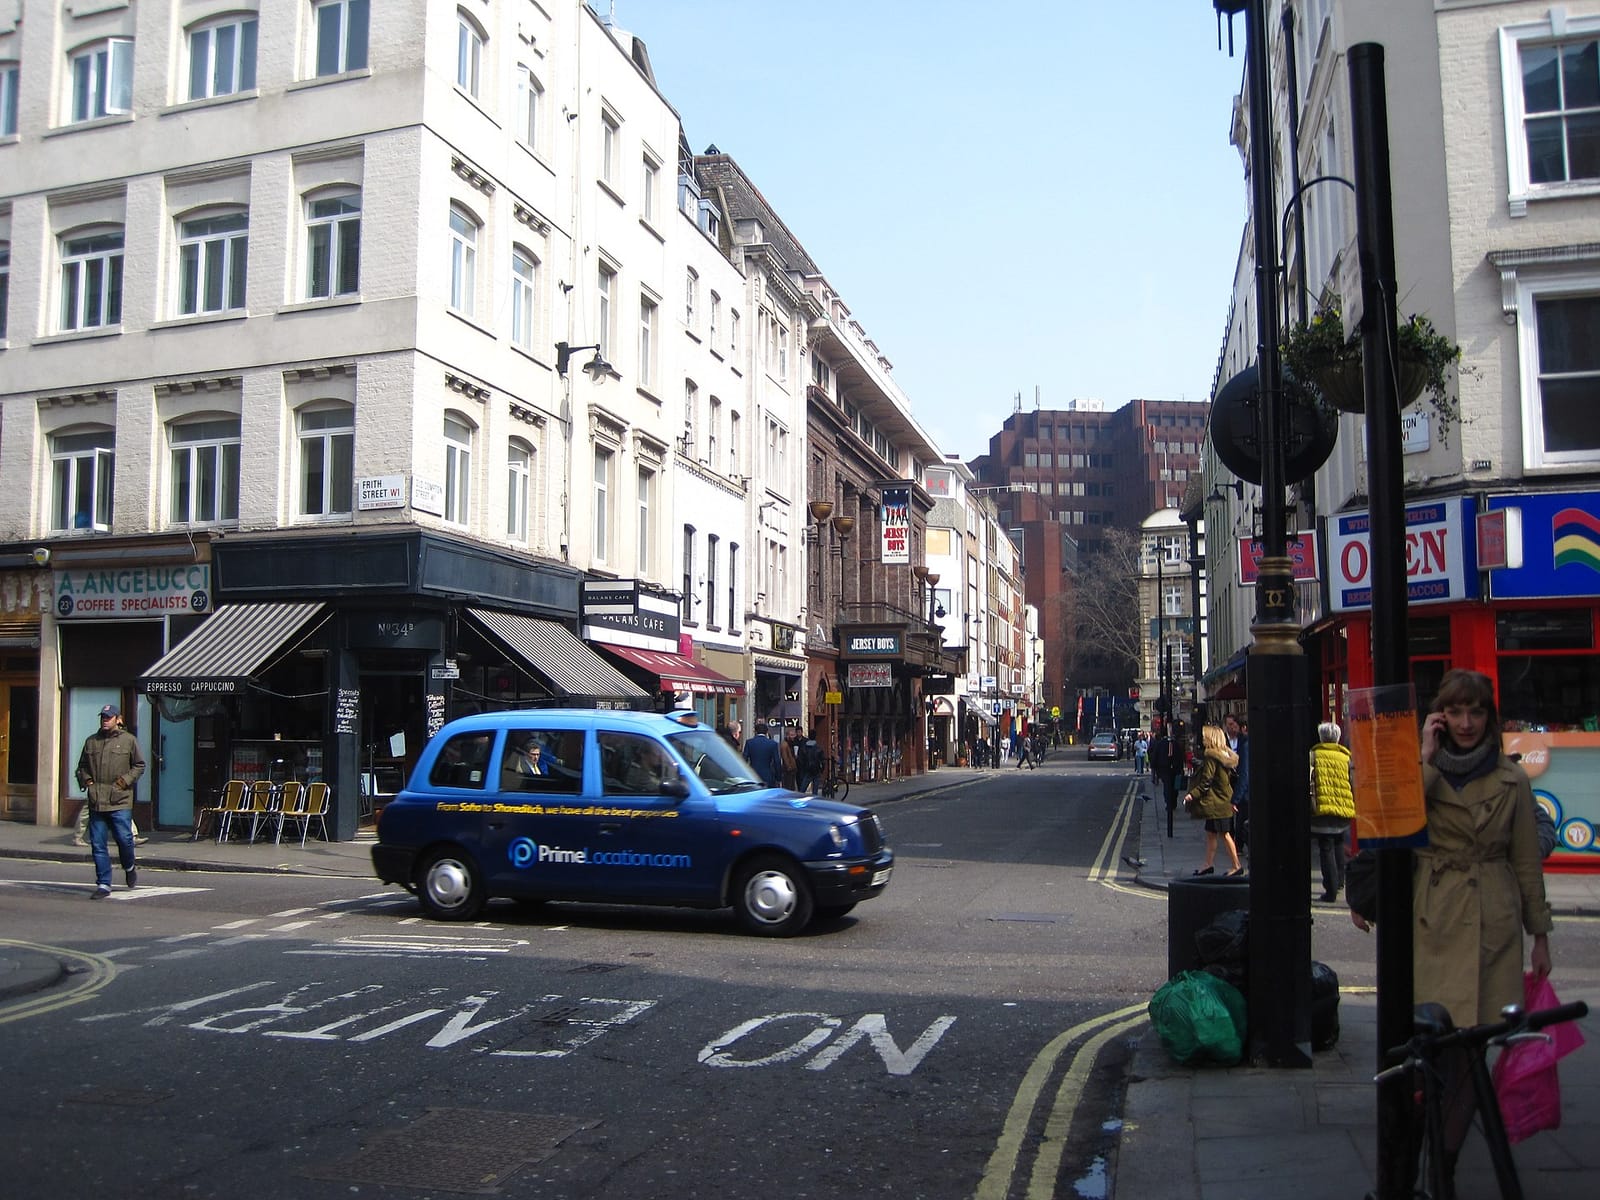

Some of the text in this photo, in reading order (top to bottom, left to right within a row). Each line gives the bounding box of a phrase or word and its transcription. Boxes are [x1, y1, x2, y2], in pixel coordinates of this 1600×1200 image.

[362, 480, 382, 489] FRITH
[362, 488, 400, 499] STREET W1
[883, 528, 908, 539] JERSEY
[887, 540, 905, 551] BOYS
[1341, 528, 1447, 584] OEN
[58, 565, 209, 594] A.ANGELUCCI
[76, 599, 115, 611] COFFEE
[121, 596, 187, 610] SPECIALISTS
[643, 617, 664, 631] CAFE
[851, 638, 894, 650] JERSEY BOYS
[147, 682, 235, 692] ESPRESSO CAPPUCCINO
[1383, 709, 1415, 719] NOTICE
[437, 802, 459, 811] From
[460, 802, 482, 812] Soho
[560, 806, 582, 815] have
[595, 807, 610, 815] the
[610, 807, 631, 816] best
[538, 845, 692, 868] PrimeLocation.com
[698, 1012, 957, 1075] NO
